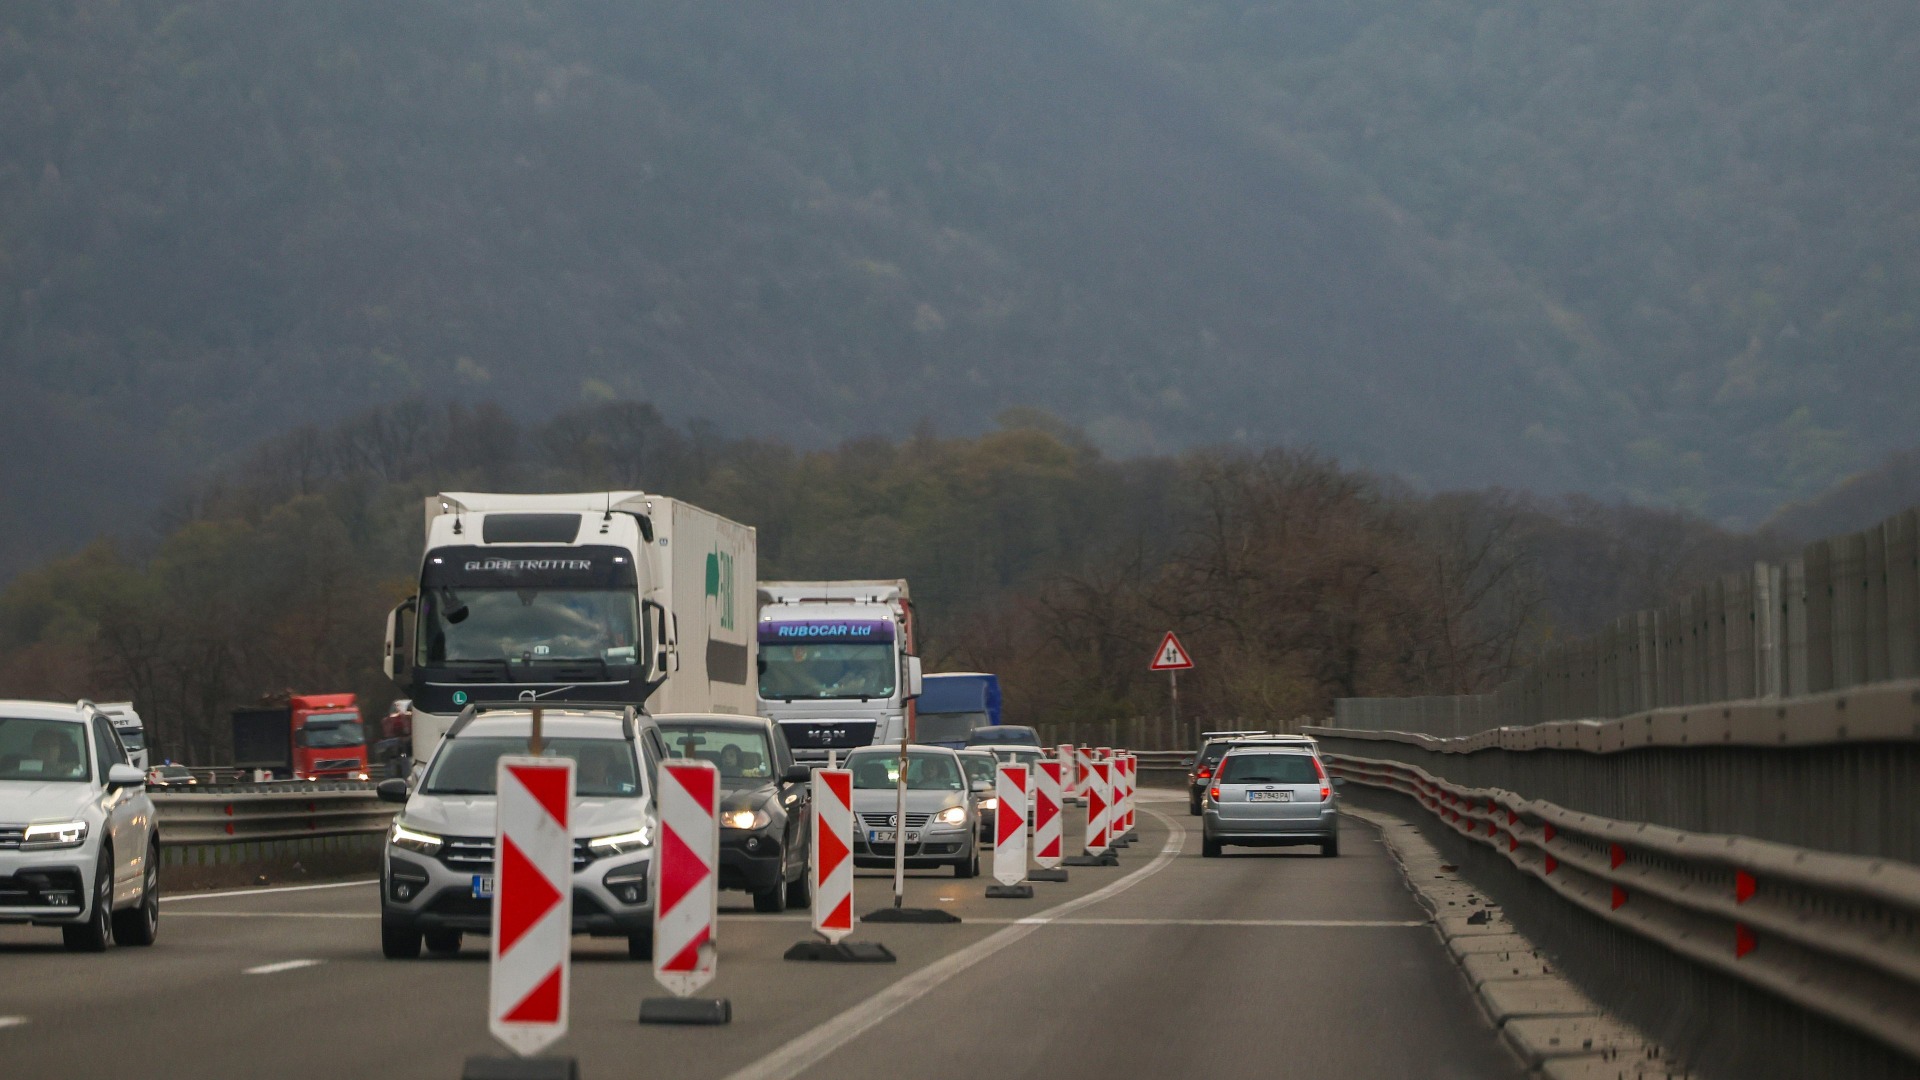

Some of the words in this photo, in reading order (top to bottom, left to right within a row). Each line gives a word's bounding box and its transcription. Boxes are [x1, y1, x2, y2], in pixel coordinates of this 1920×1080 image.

[464, 559, 591, 571] GLOBETROTTER
[778, 625, 848, 637] RUBOCAR
[850, 625, 872, 636] Ltd
[808, 730, 846, 738] MAN
